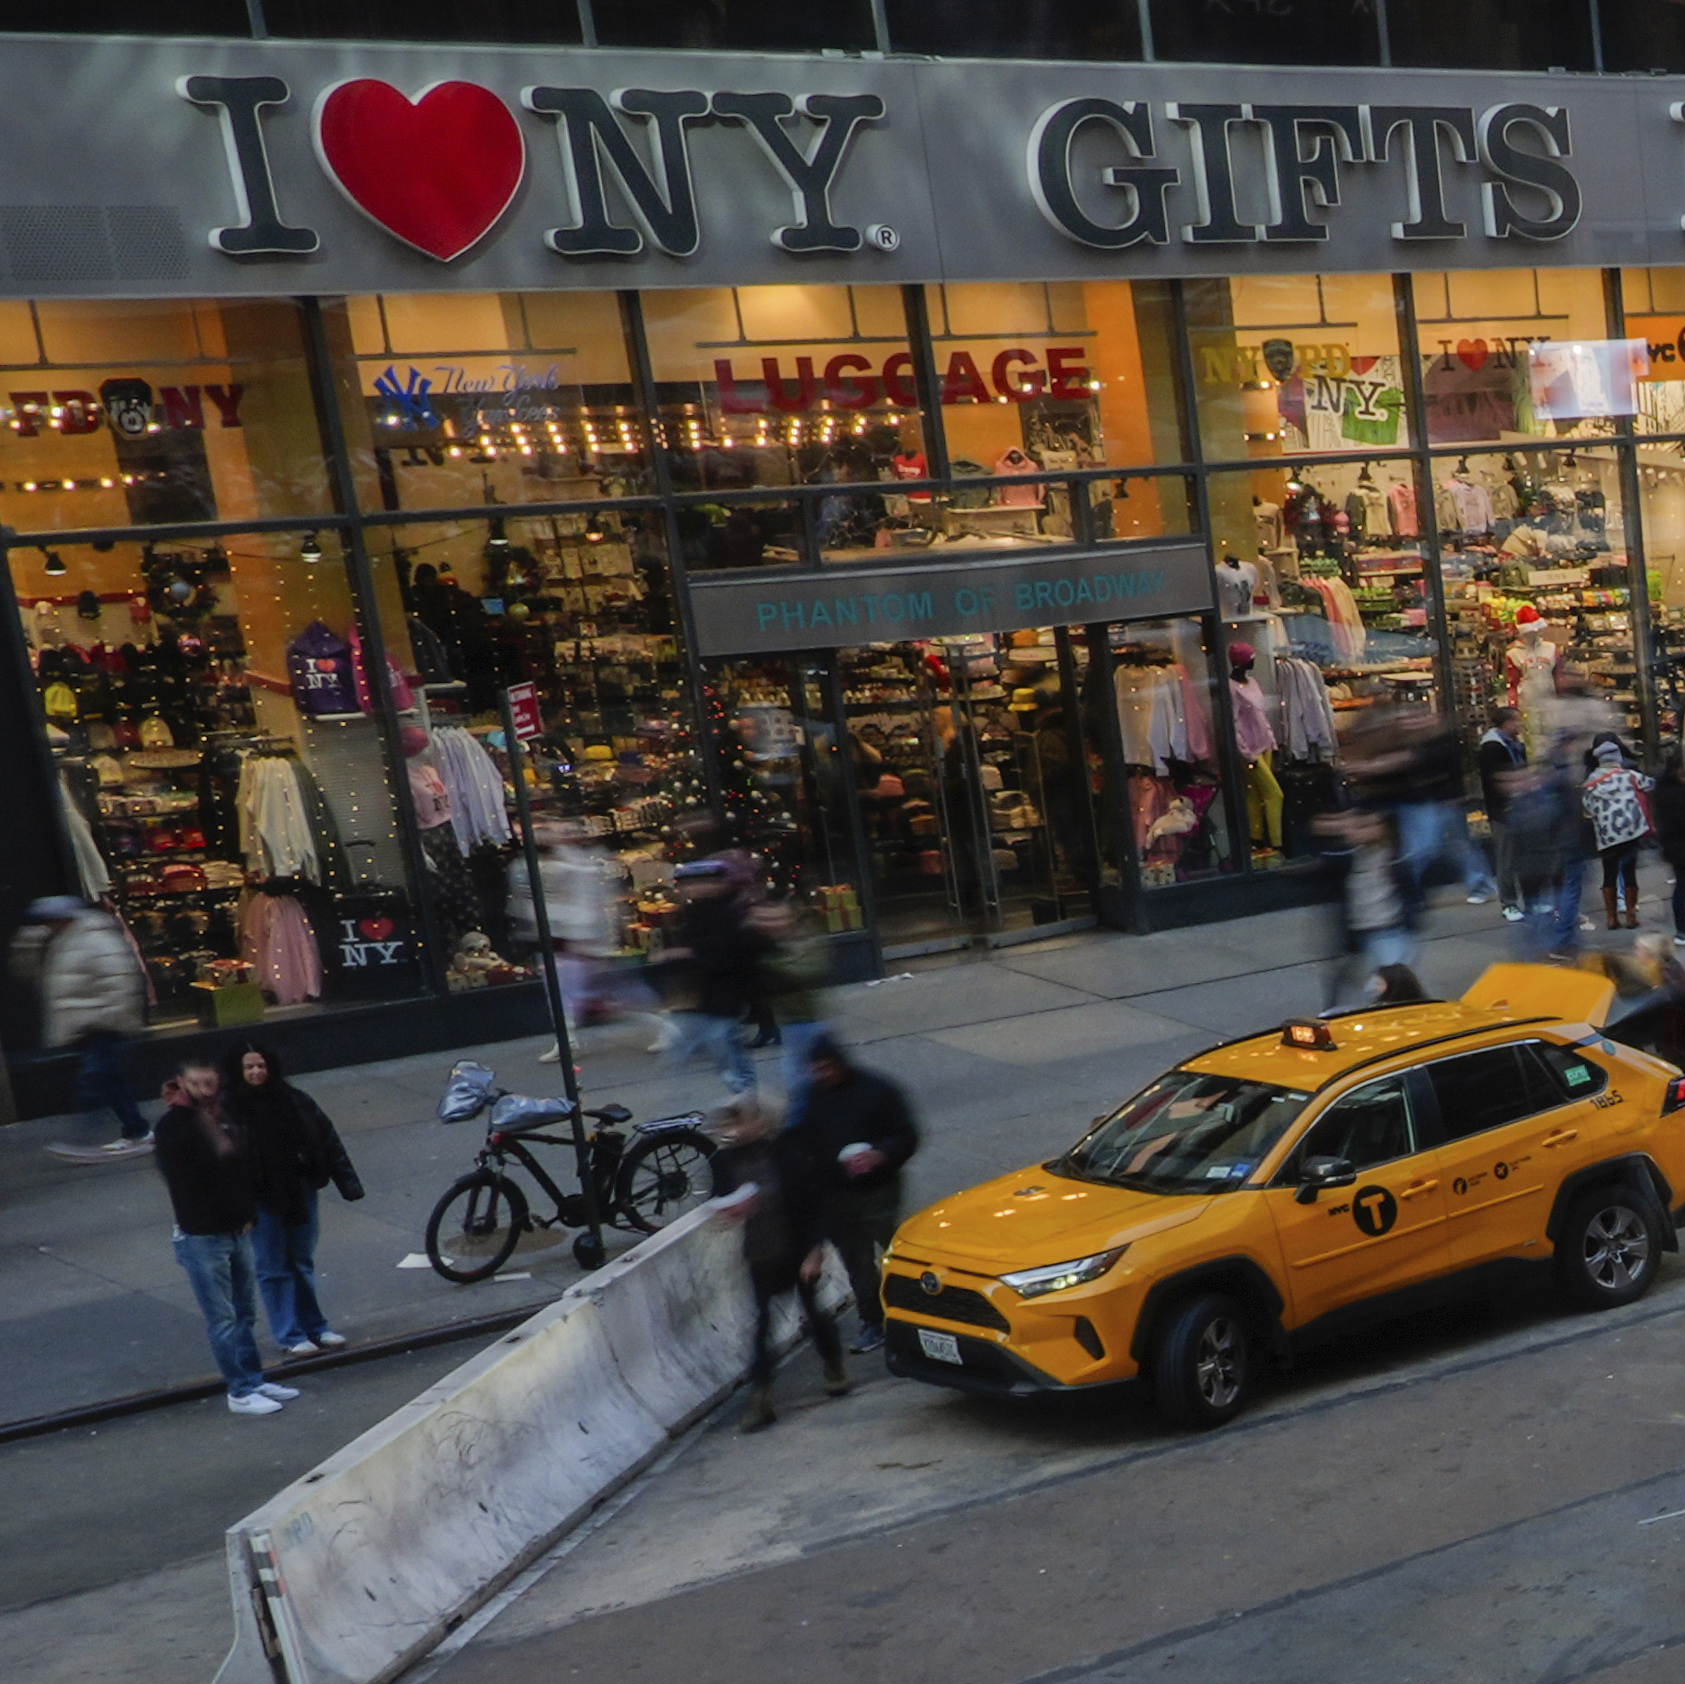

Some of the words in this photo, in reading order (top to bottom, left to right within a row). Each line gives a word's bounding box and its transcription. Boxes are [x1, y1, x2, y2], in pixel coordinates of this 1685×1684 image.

[174, 74, 320, 254] I
[520, 84, 886, 257] NY
[1026, 96, 1583, 251] GIFTS
[1437, 340, 1456, 372] I
[1647, 343, 1676, 363] YC
[713, 347, 1093, 415] LUGGAGE
[756, 593, 934, 630] PHANTOM
[954, 587, 997, 617] OF
[1015, 571, 1168, 611] BROADWAY
[306, 658, 317, 674] I
[305, 673, 339, 689] NY
[340, 920, 360, 943] I
[338, 941, 404, 967] NY
[1327, 1203, 1350, 1218] NYC
